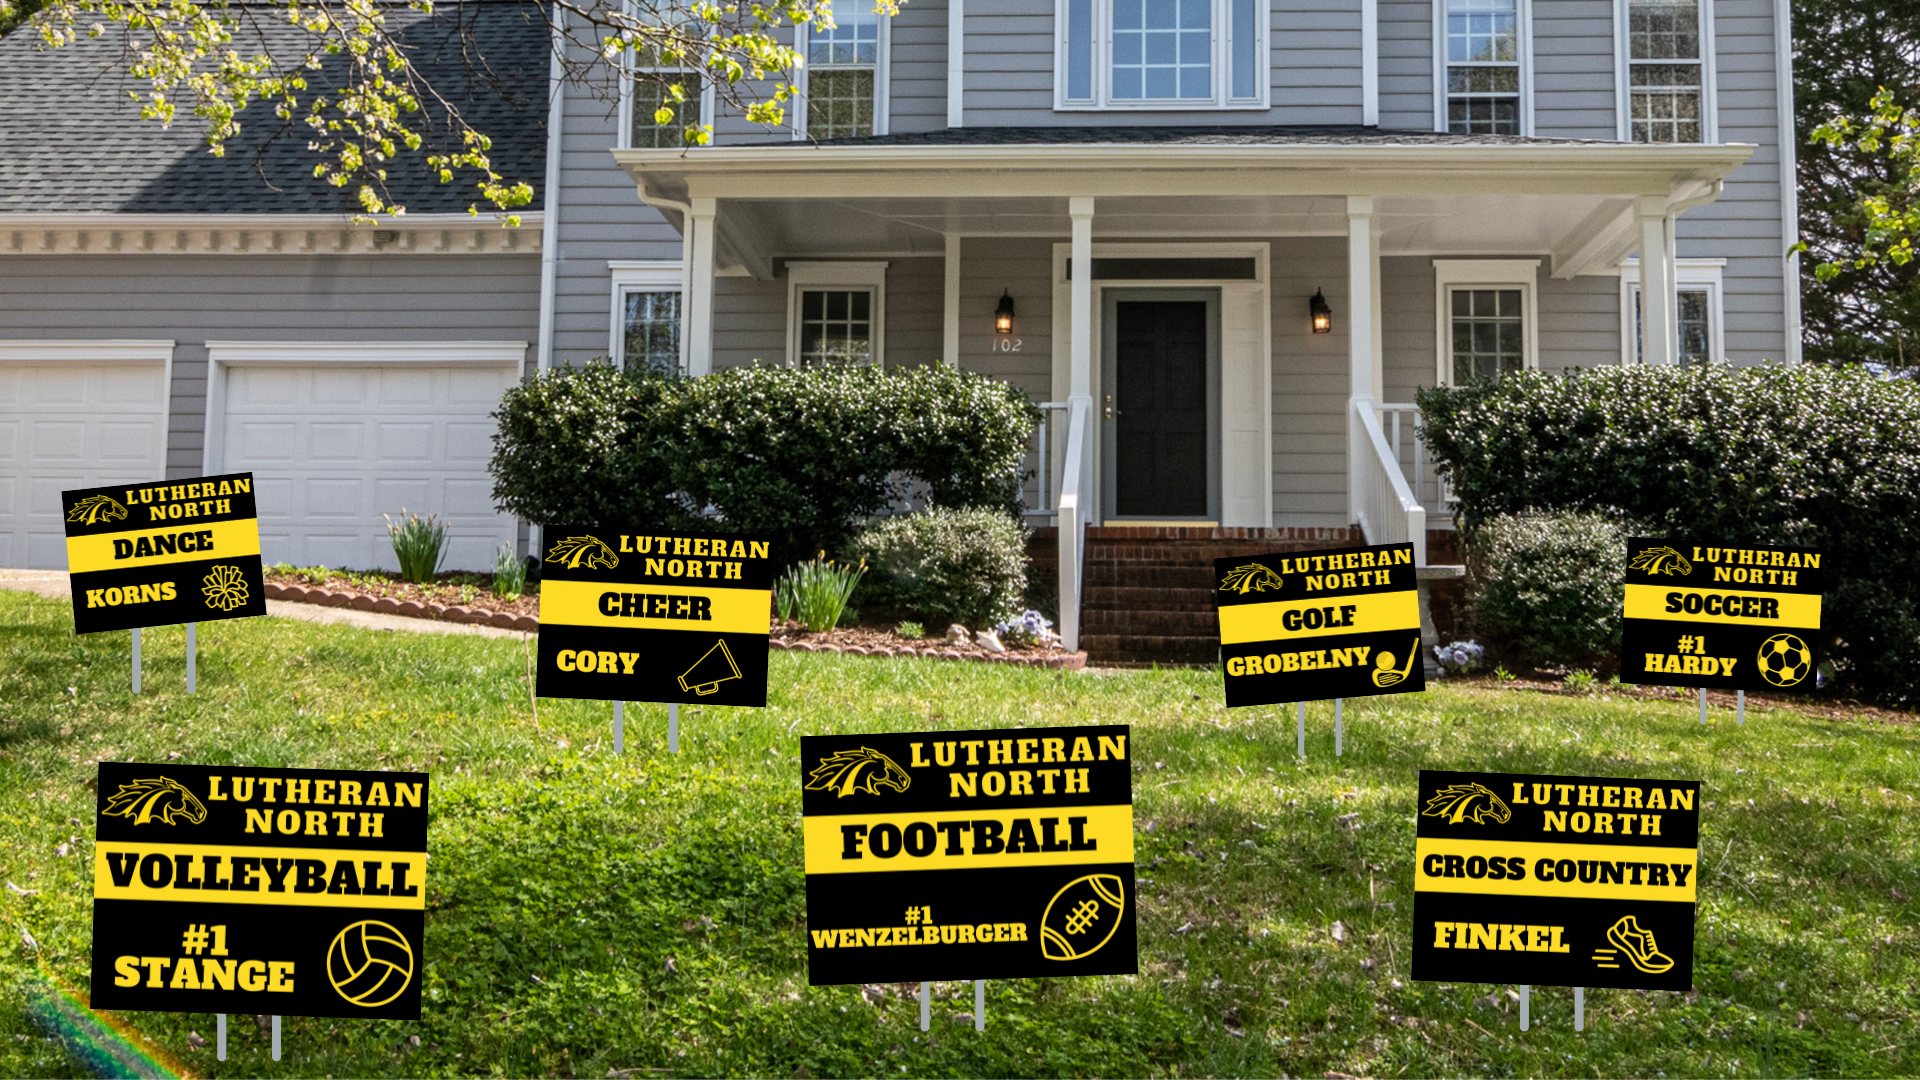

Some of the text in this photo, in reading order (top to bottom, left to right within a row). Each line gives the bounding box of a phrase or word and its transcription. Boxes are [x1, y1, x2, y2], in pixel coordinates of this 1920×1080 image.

[992, 339, 1022, 352] 102
[126, 479, 251, 505] LUTHERAN
[150, 498, 231, 520] NORTH
[113, 530, 213, 559] DANCE
[620, 535, 769, 558] LUTHERAN
[1693, 547, 1821, 568] LUTHERAN
[645, 558, 742, 579] NORTH
[1281, 549, 1411, 574] LUTHERAN
[1306, 570, 1390, 591] NORTH
[1714, 567, 1797, 585] NORTH
[86, 582, 176, 608] KORNS
[599, 592, 711, 620] CHEER
[1666, 592, 1779, 618] SOCCER
[1282, 605, 1356, 631] GOLF
[1678, 635, 1705, 654] #1
[557, 650, 639, 674] CORY
[1227, 646, 1370, 676] GROBELNY
[1645, 653, 1737, 676] HARDY
[910, 736, 1125, 767] LUTHERAN
[209, 776, 422, 807] LUTHERAN
[950, 768, 1090, 797] NORTH
[1512, 783, 1694, 810] LUTHERAN
[245, 809, 384, 837] NORTH
[1543, 811, 1661, 835] NORTH
[841, 817, 1097, 859] FOOTBALL
[106, 852, 418, 897] VOLLEYBALL
[1423, 854, 1692, 886] CROSS COUNTRY
[905, 906, 932, 925] #1
[182, 924, 228, 955] #1
[811, 923, 1027, 948] WENZELBURGER
[1434, 922, 1569, 953] FINKEL
[115, 956, 294, 992] STANGE
